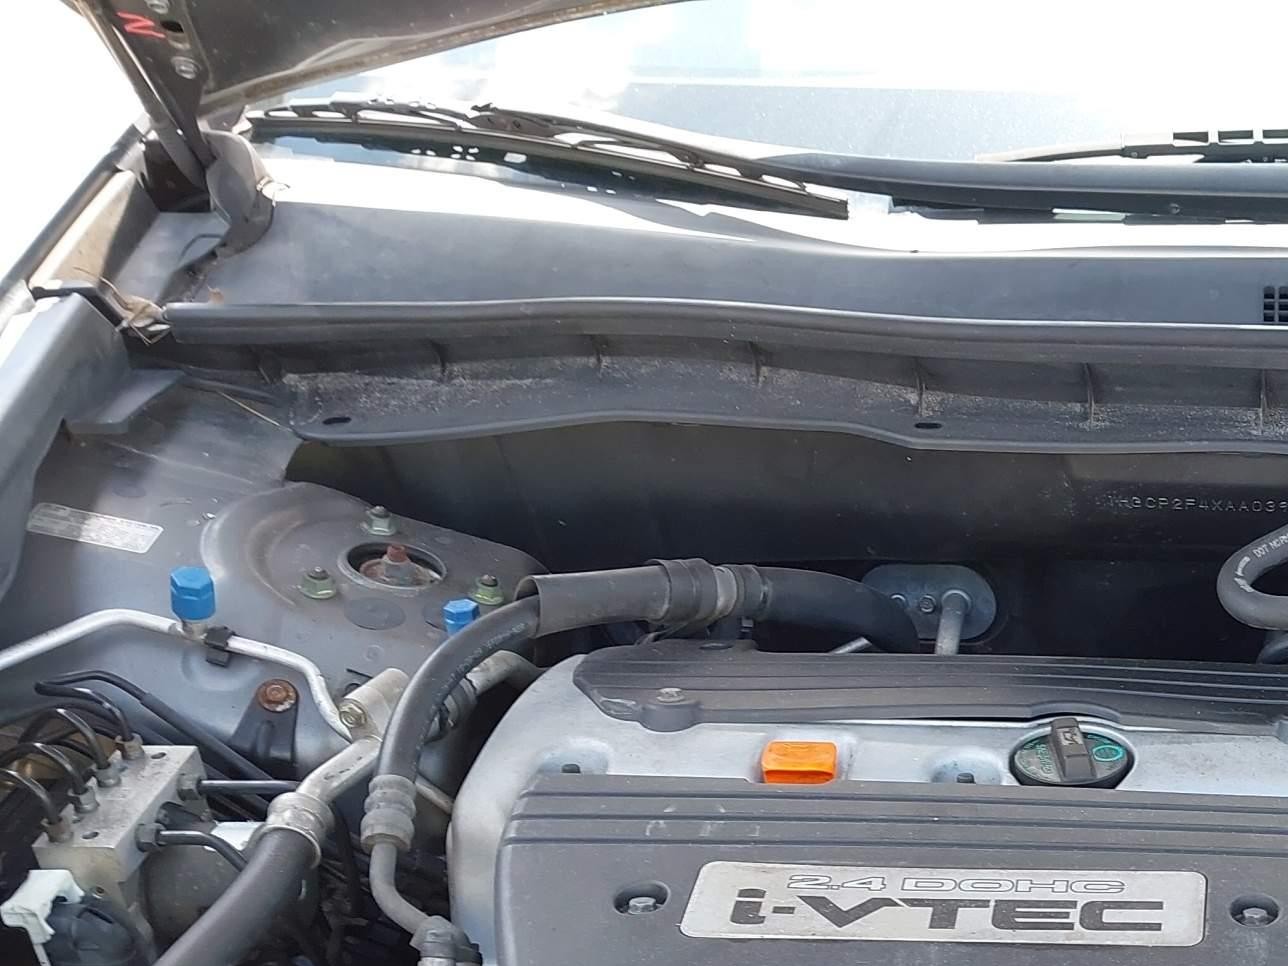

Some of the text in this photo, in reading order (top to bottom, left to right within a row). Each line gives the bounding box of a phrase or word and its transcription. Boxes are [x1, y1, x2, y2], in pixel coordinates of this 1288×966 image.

[787, 875, 1127, 894] 2.4 DOHC
[730, 888, 1164, 932] i-VTEC
